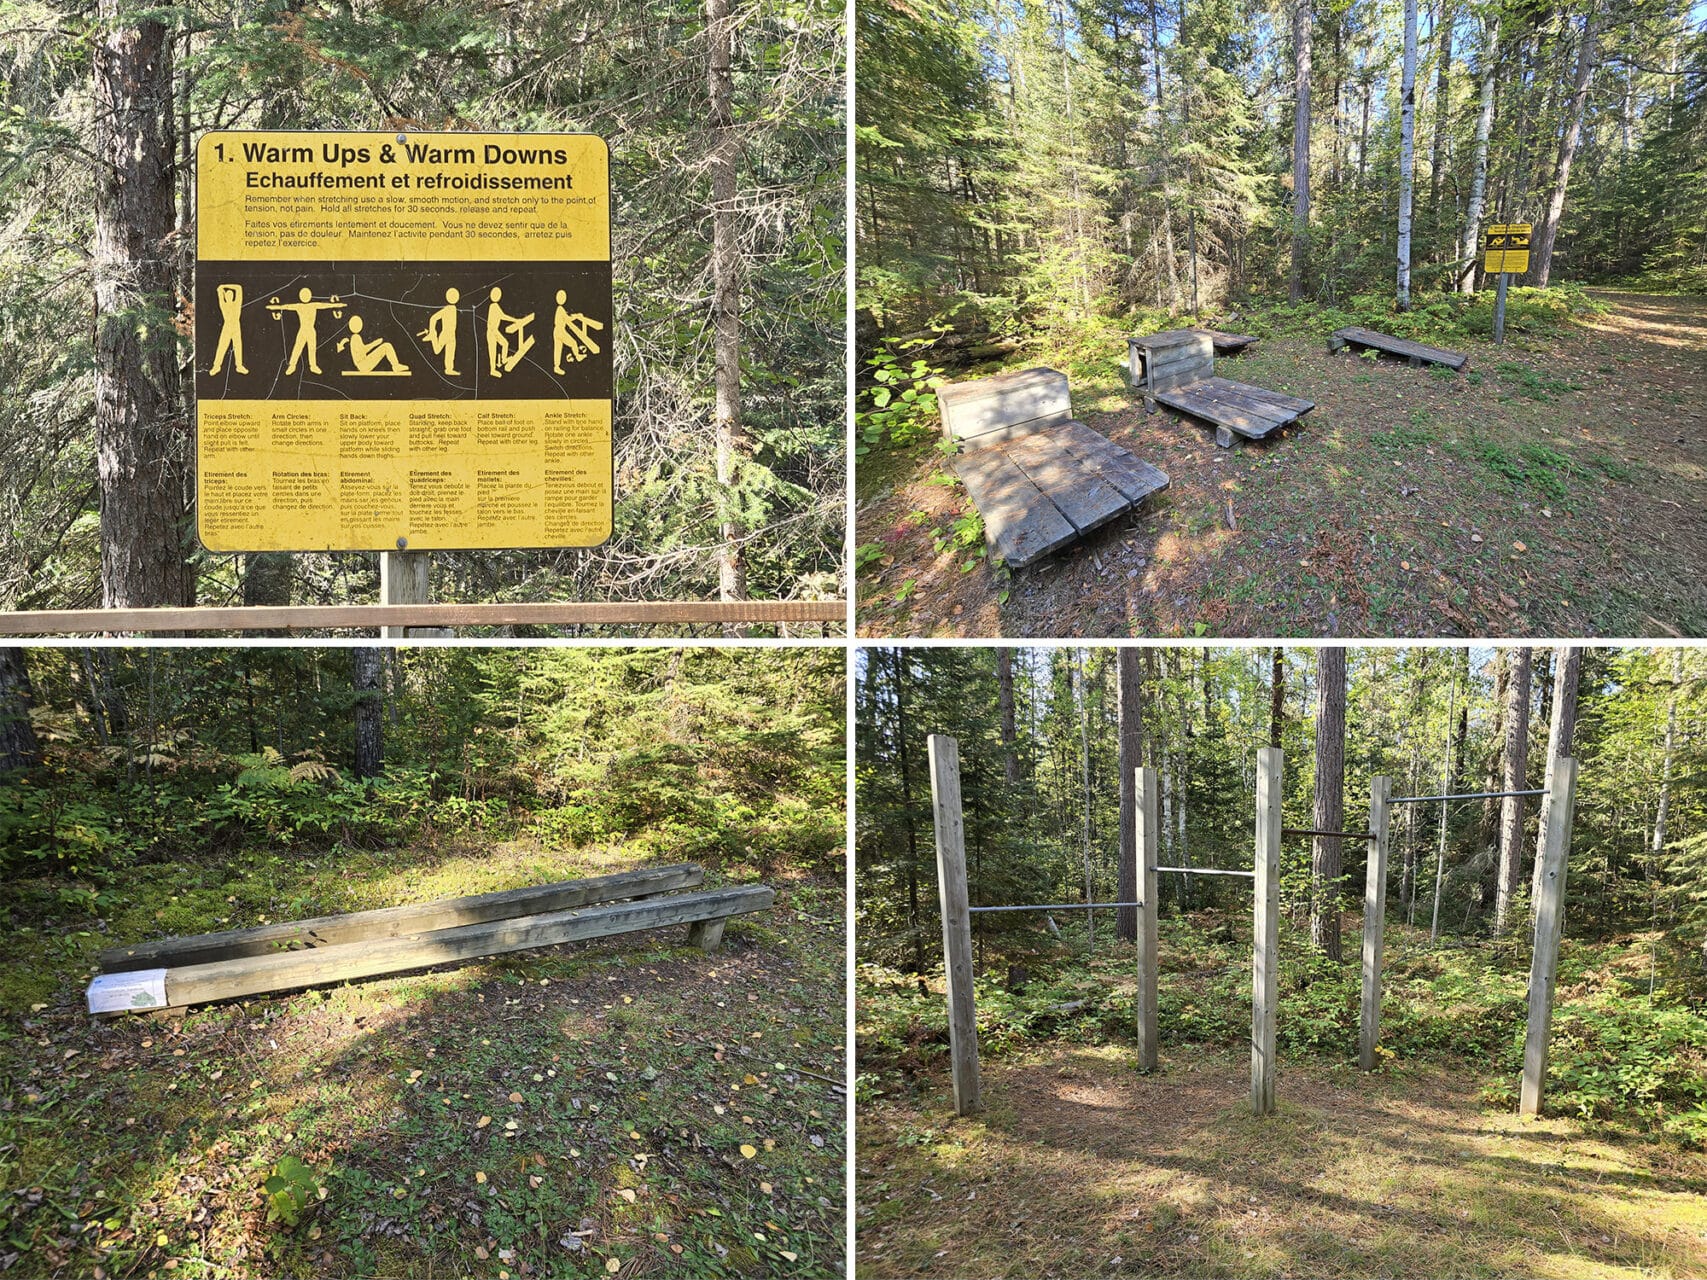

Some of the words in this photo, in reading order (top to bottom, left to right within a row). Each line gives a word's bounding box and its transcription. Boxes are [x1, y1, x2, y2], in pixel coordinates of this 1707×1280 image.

[214, 143, 234, 162] 1.
[243, 143, 313, 162] Warm
[323, 144, 370, 168] Ups
[379, 144, 396, 163] &
[405, 144, 475, 164] Warm
[484, 144, 567, 164] Downs
[246, 172, 385, 188] Echauffement
[392, 174, 410, 189] et
[416, 173, 572, 189] refroidissement
[318, 196, 358, 204] stretching
[523, 197, 538, 206] only
[245, 205, 277, 213] tension,
[290, 220, 333, 228] etirements
[336, 220, 376, 228] lentement
[430, 231, 463, 240] pendant
[555, 231, 572, 240] puis
